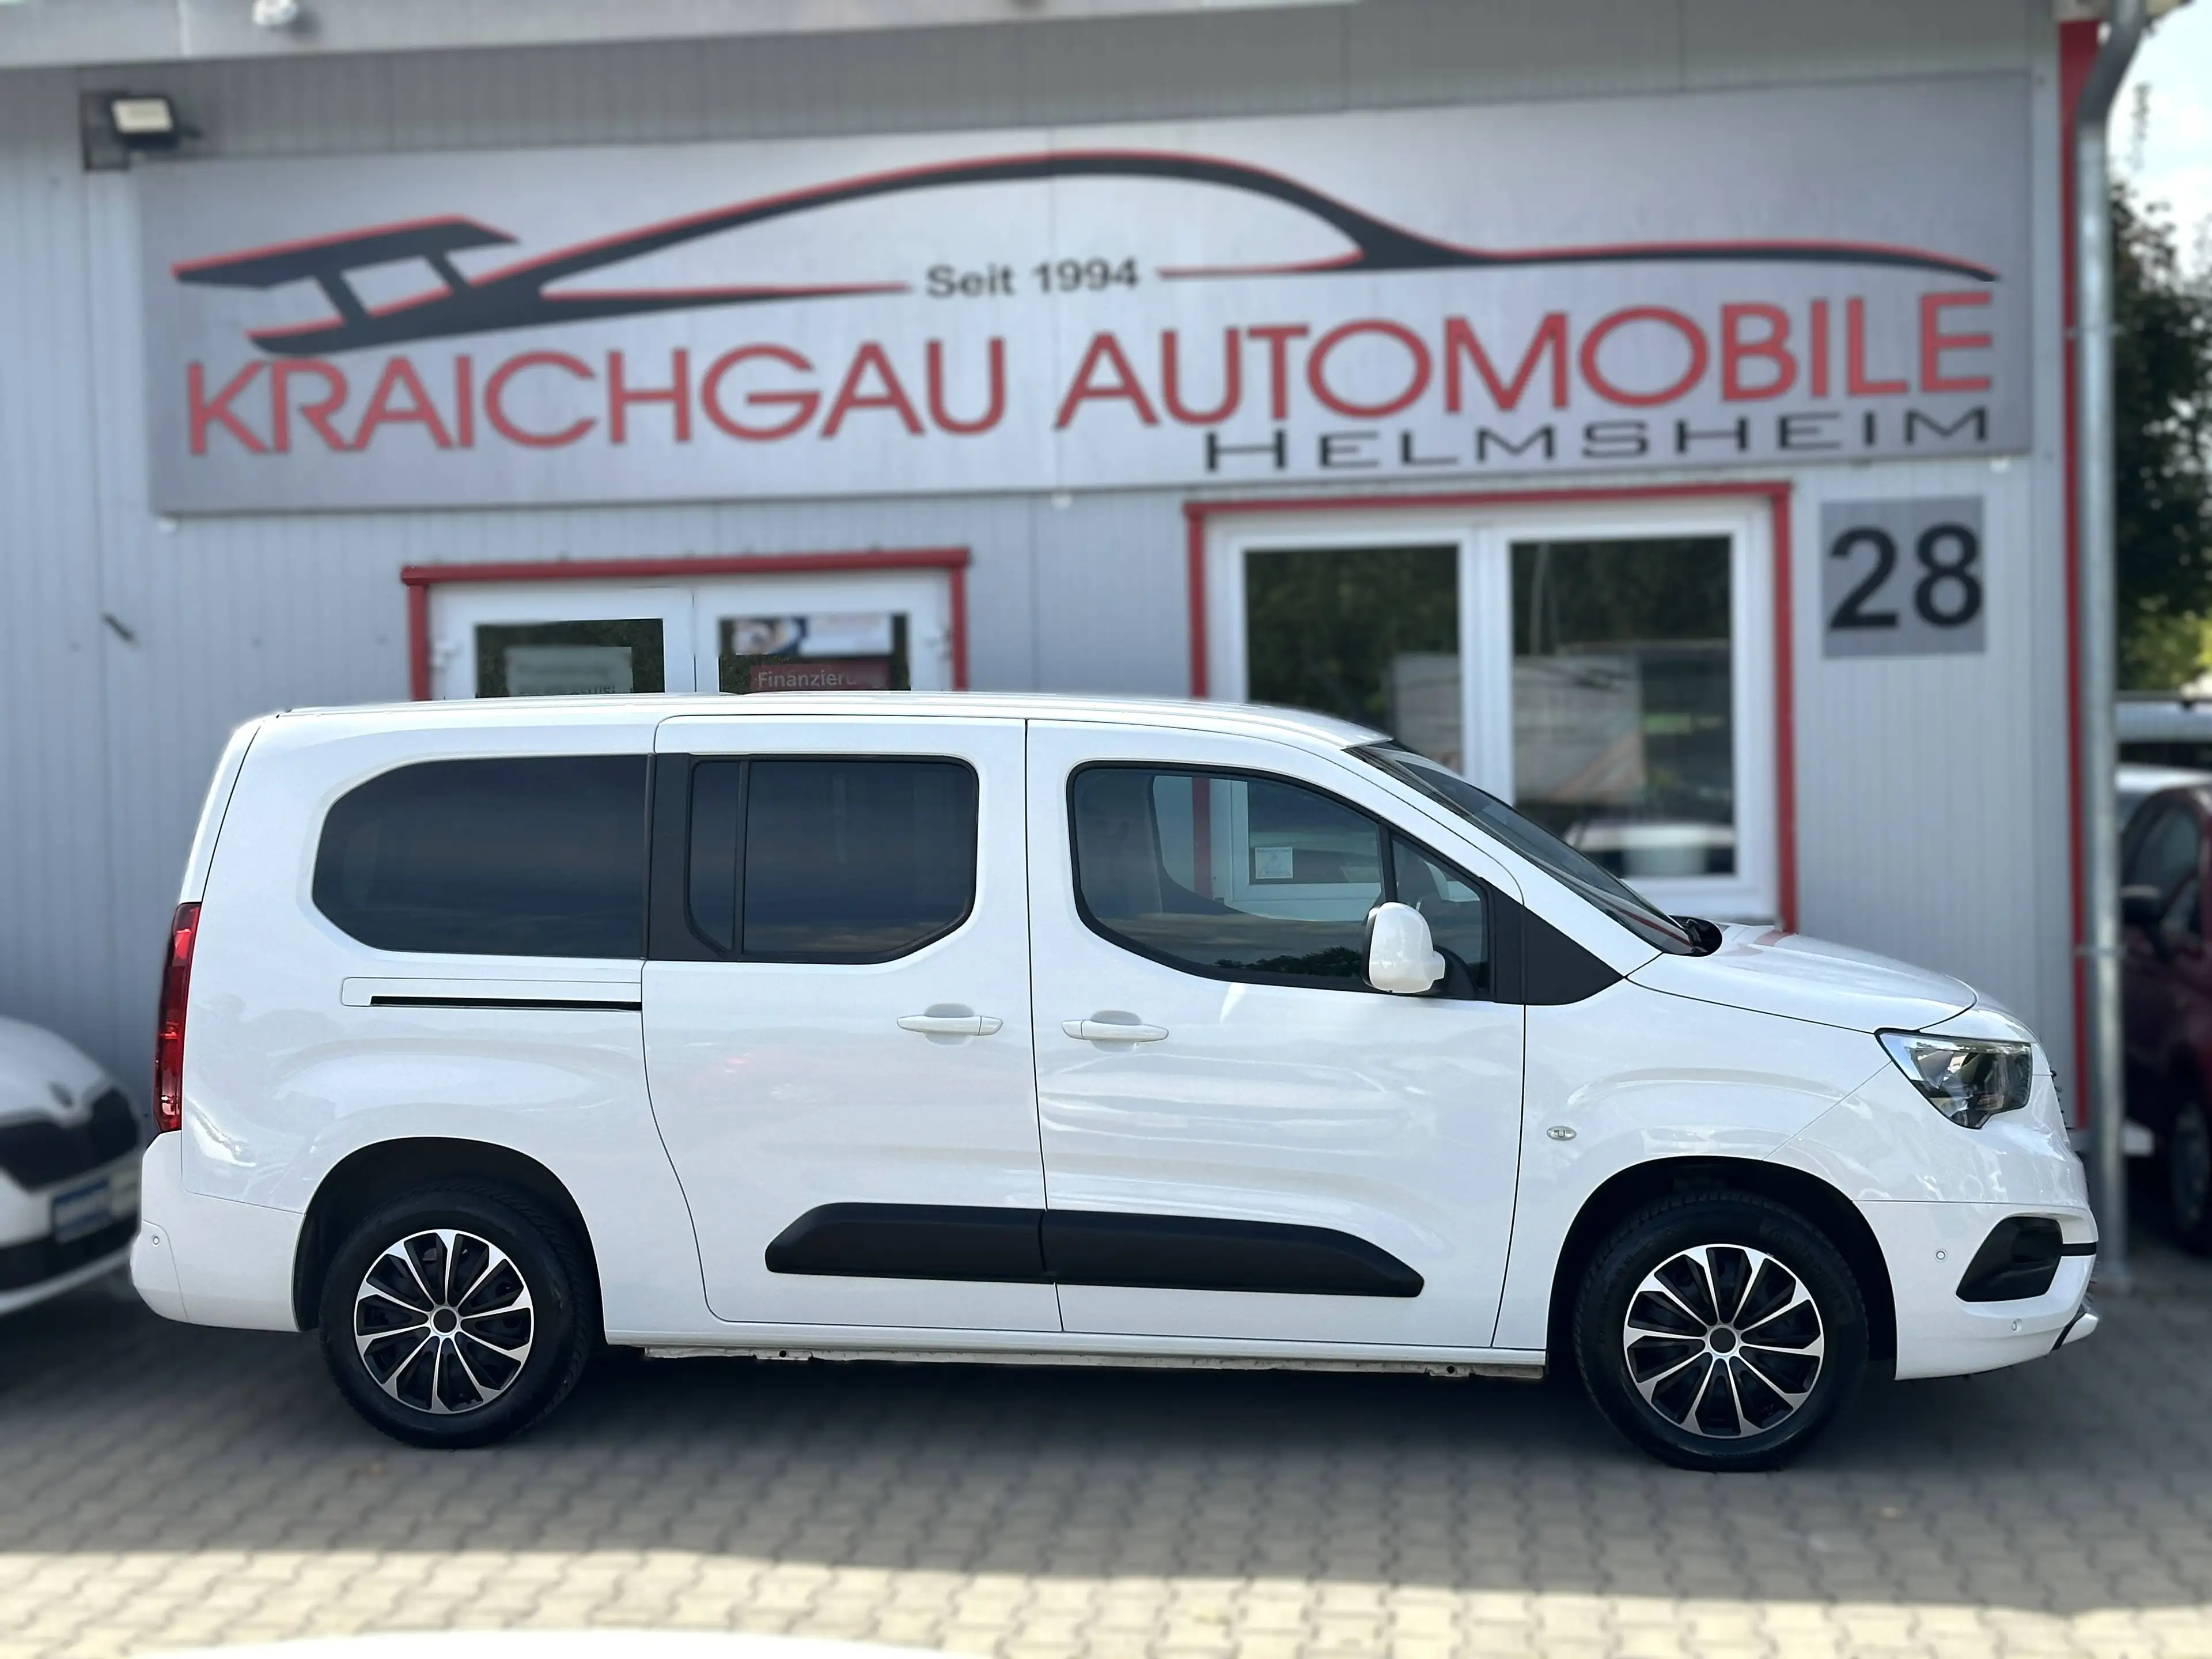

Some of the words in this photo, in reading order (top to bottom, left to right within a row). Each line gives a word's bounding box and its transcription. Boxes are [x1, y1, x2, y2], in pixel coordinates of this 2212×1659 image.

[926, 263, 1016, 298] Seit
[1034, 257, 1139, 294] 1994
[189, 339, 1004, 454] KRAICHGAU
[1058, 292, 1990, 427] AUTOMOBILE
[1207, 406, 1989, 471] HELMSHEIM
[1829, 524, 1983, 630] 28
